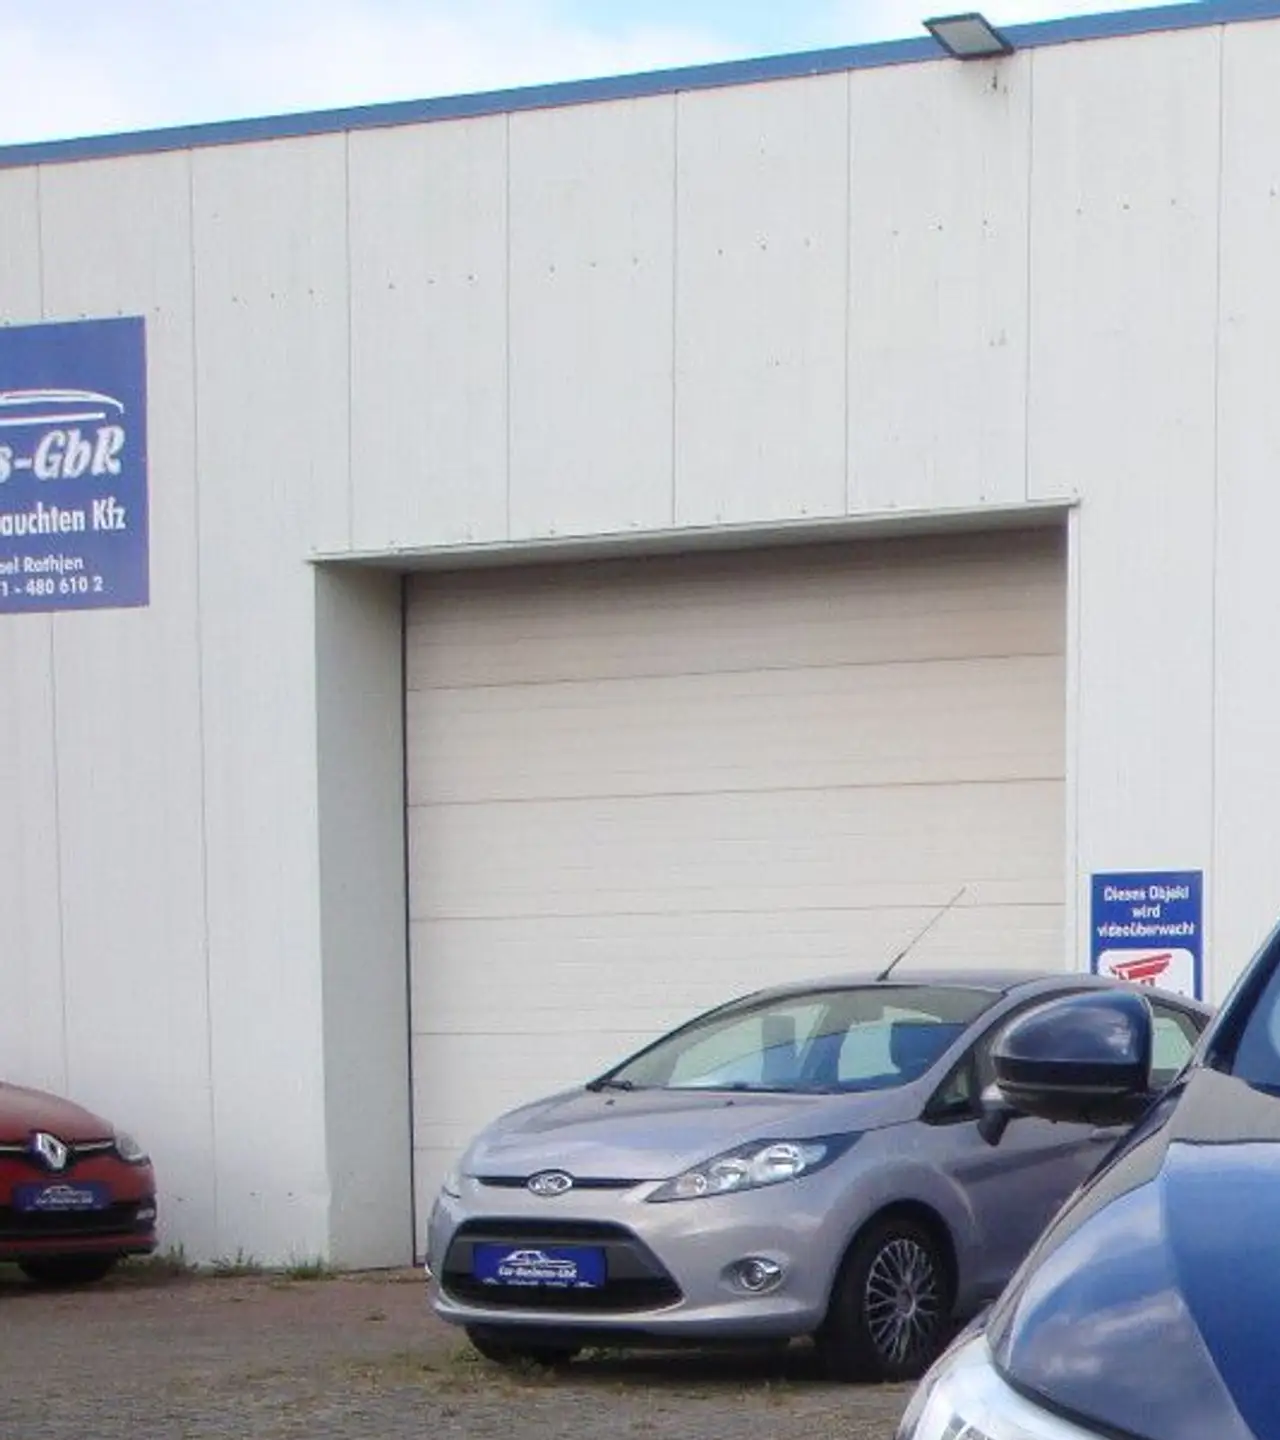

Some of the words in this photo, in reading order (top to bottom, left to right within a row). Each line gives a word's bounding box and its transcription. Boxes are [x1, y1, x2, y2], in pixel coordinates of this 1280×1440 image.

[92, 496, 126, 531] Kfz
[26, 577, 55, 596] 480
[60, 575, 88, 594] 610
[93, 575, 104, 592] 2
[1131, 904, 1161, 919] wird
